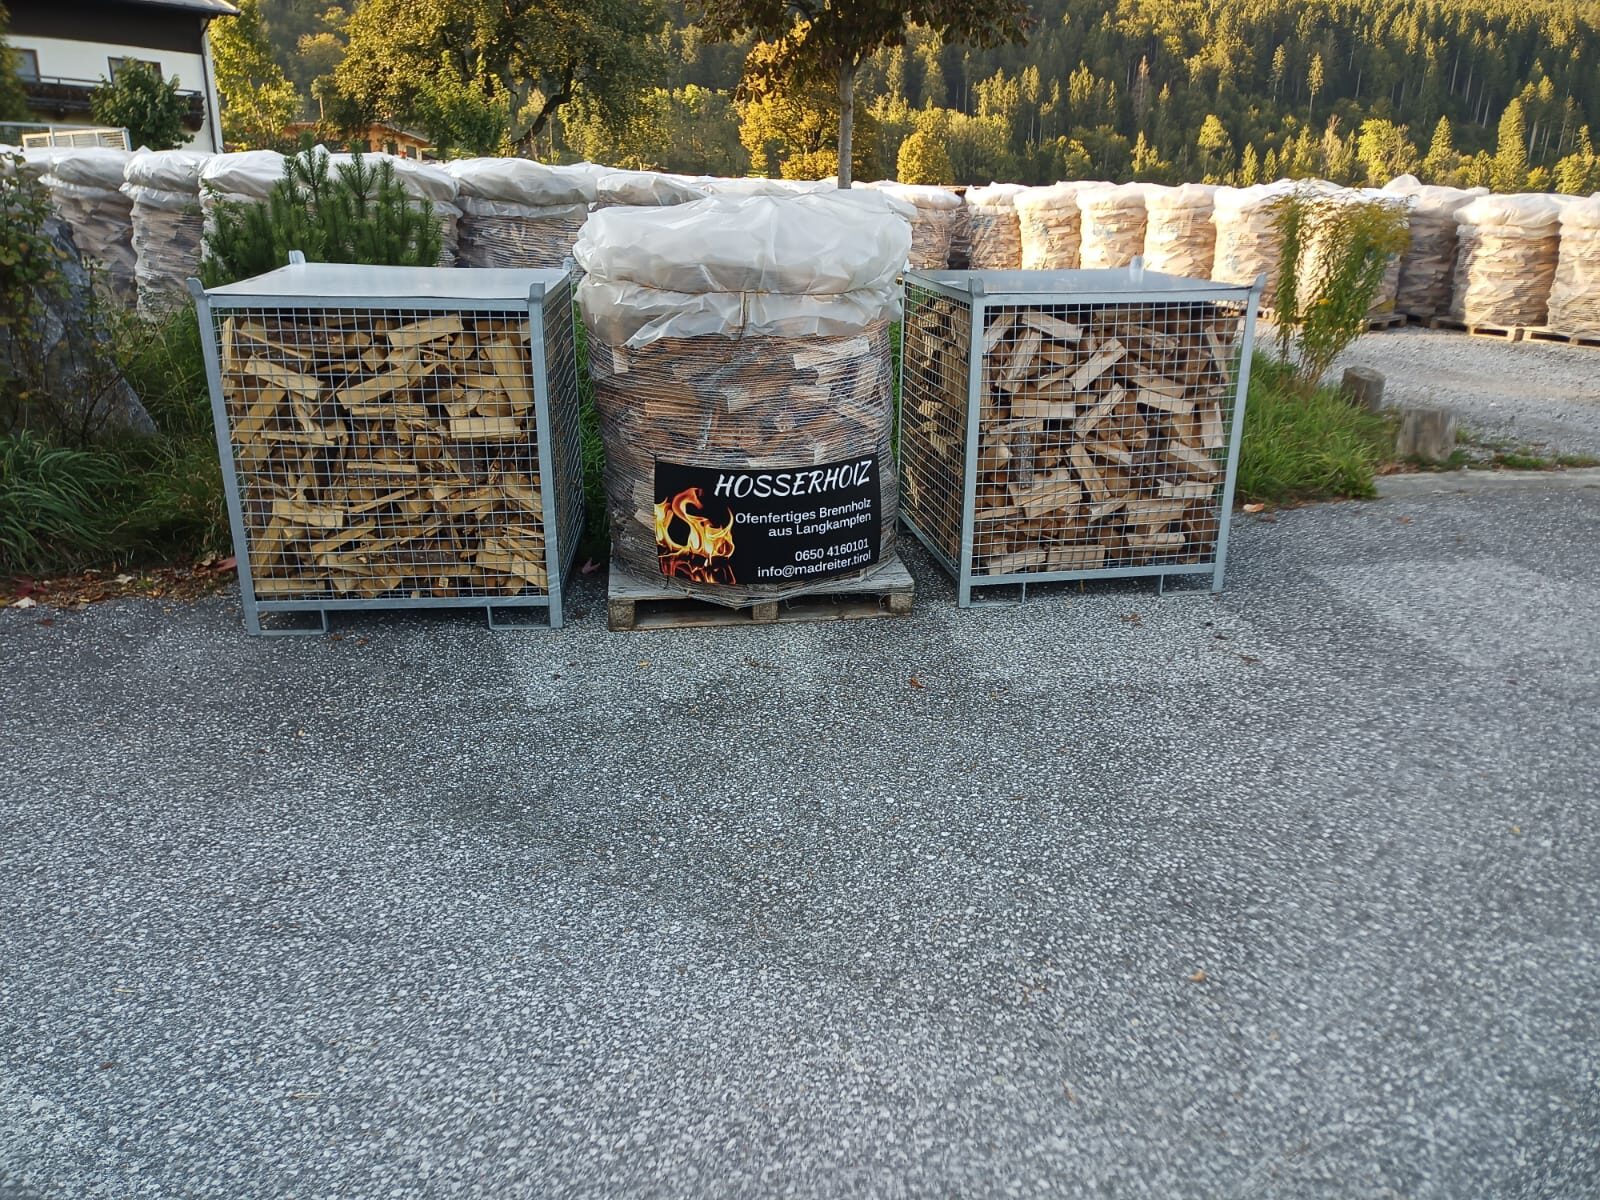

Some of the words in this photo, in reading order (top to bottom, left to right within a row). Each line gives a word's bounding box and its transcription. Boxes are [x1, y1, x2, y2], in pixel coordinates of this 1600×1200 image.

[735, 511, 817, 524] Ofenfertiges
[819, 498, 871, 518] Brennholz
[768, 526, 792, 537] aus
[796, 513, 871, 536] Langkampfen
[795, 549, 824, 562] 0650
[827, 538, 869, 558] 4160101
[757, 551, 871, 578] info@madreiter.tirol
